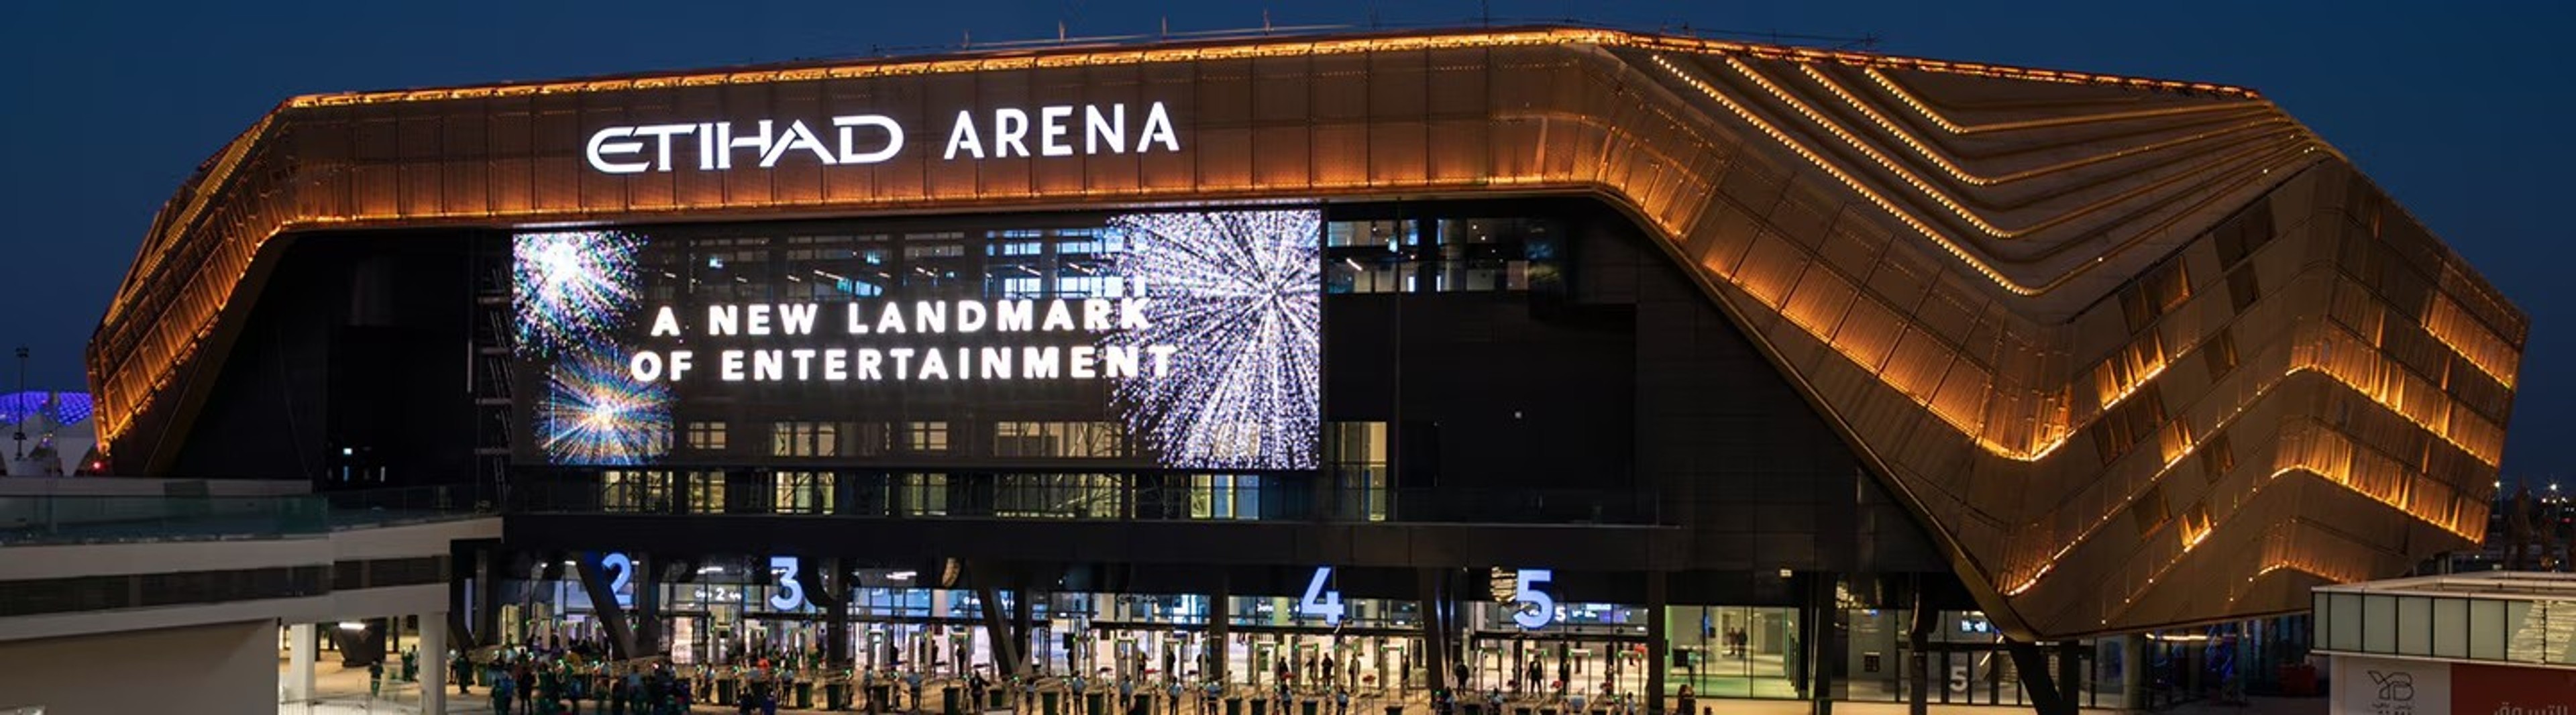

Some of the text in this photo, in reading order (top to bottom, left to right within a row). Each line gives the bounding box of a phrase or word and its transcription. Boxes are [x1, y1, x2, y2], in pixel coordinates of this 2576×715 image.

[586, 101, 1181, 173] ETIHAD ARENA
[651, 297, 1152, 336] A NEW LANDMARK
[629, 344, 1177, 382] OF ENTERTAINMENT
[602, 553, 632, 604] 2
[714, 587, 725, 601] 2
[770, 557, 802, 610] 3
[1301, 567, 1344, 624] 4
[1513, 569, 1554, 628] 5
[1554, 606, 1566, 622] 5
[1949, 666, 1968, 692] 5
